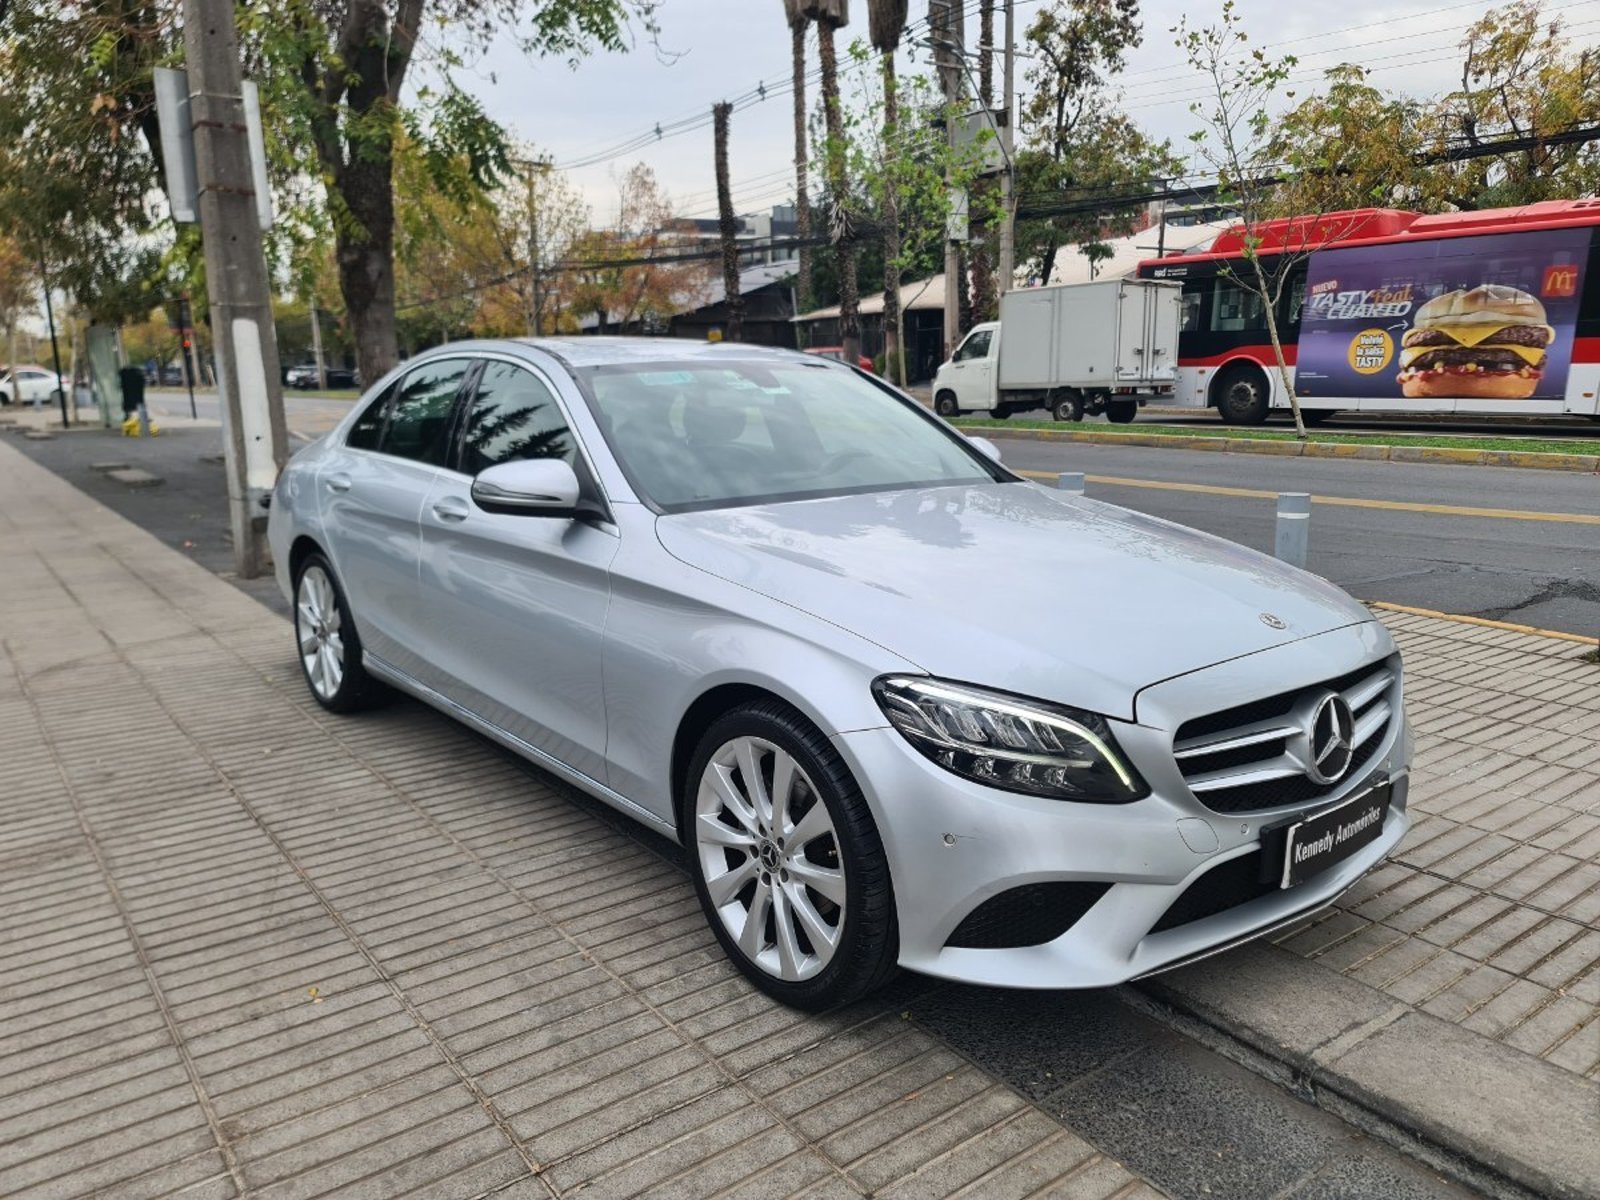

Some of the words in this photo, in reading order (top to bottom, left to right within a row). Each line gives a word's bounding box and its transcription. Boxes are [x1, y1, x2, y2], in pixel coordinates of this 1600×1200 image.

[1312, 280, 1337, 293] NUEVO
[1311, 290, 1367, 308] TASTY
[1356, 356, 1384, 367] TASTY
[1295, 830, 1334, 864] Kennedy
